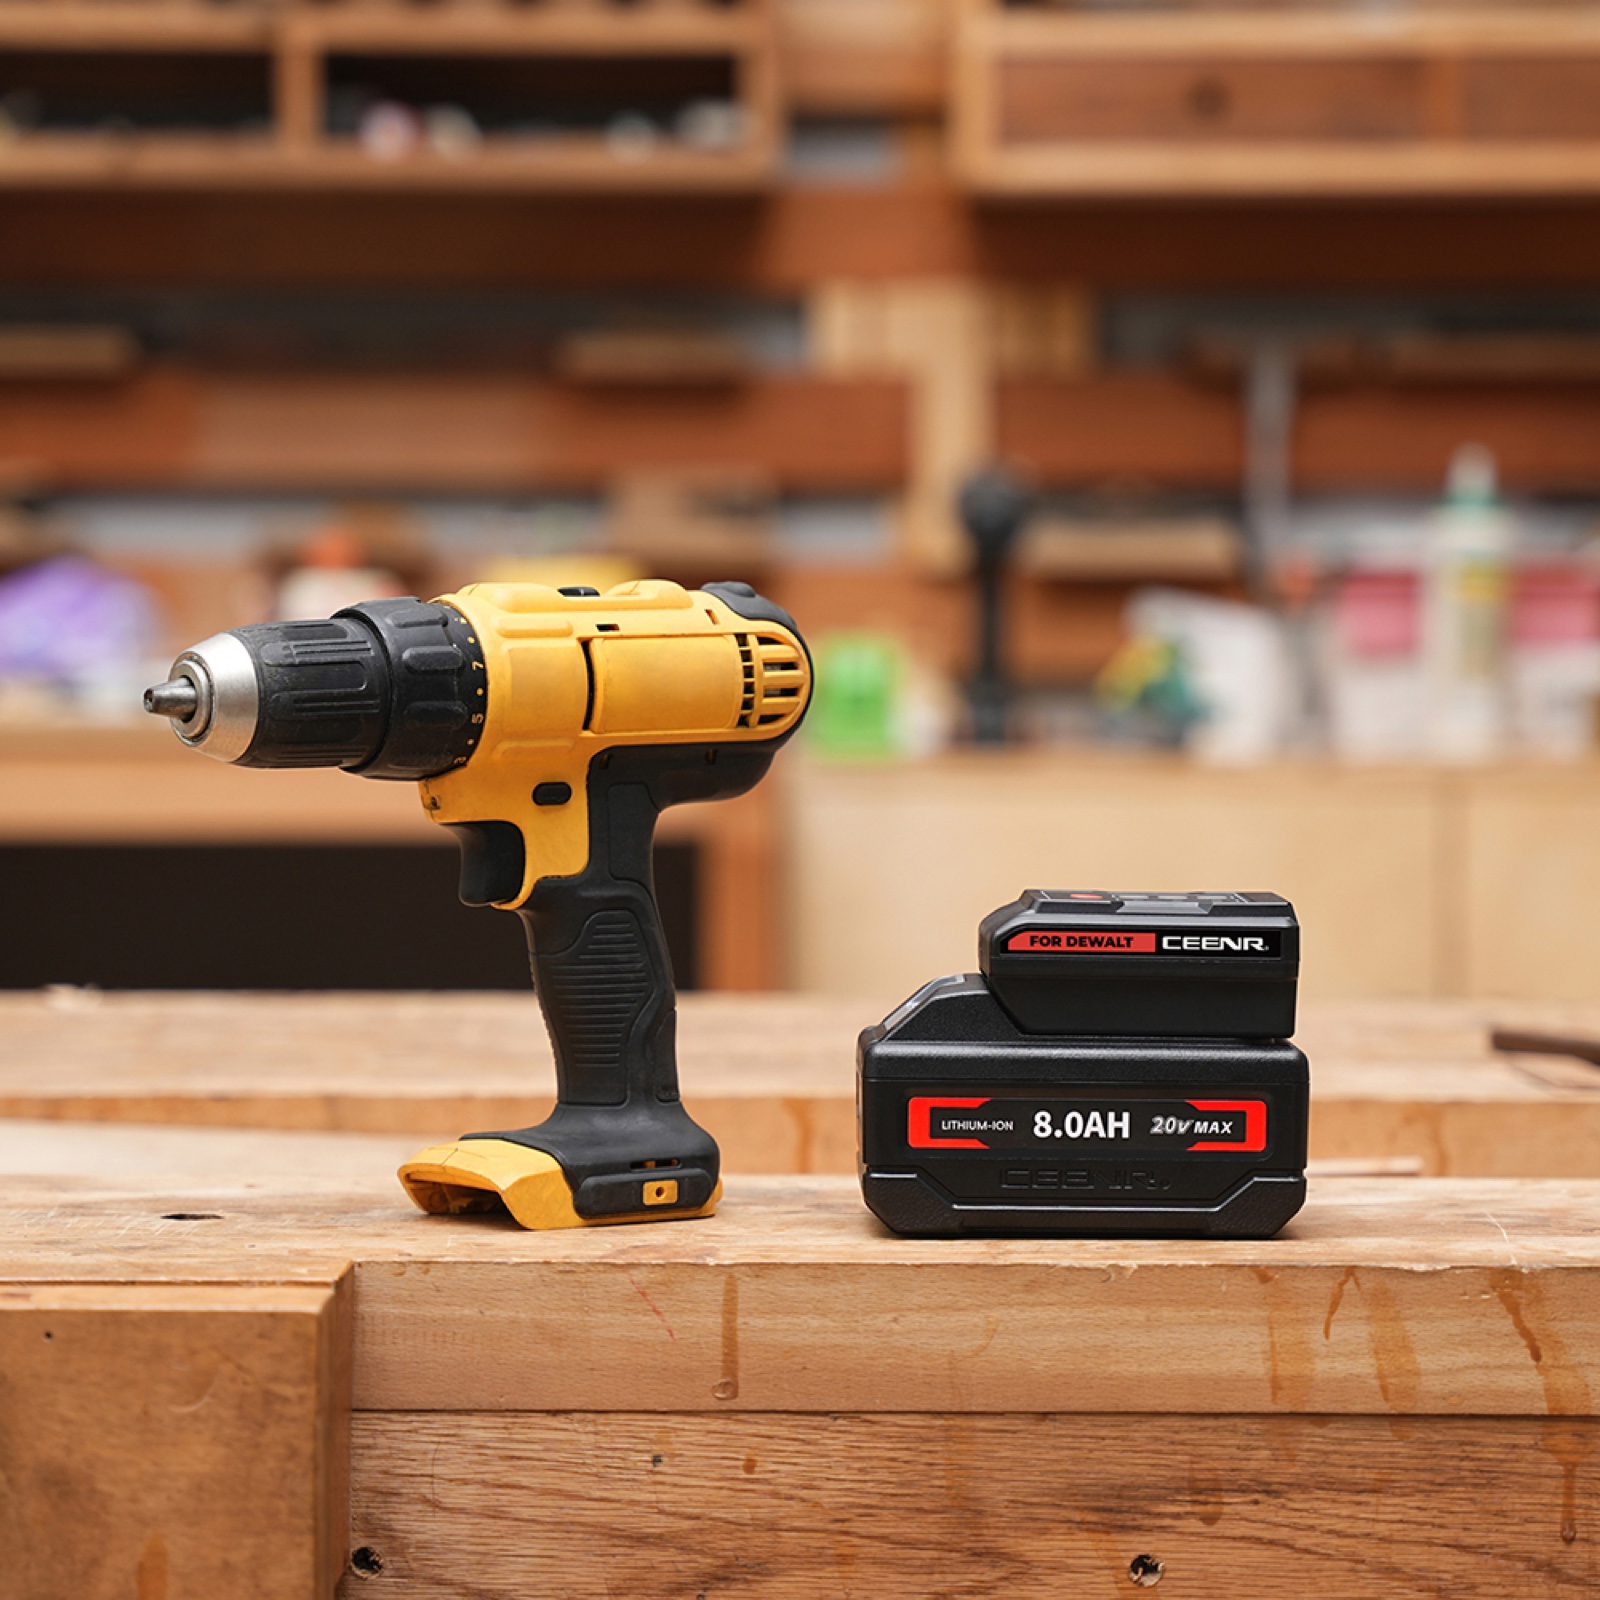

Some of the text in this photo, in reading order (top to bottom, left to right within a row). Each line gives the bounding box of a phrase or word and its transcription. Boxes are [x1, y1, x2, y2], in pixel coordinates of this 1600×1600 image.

[471, 661, 484, 670] 7
[471, 714, 484, 724] 5
[1030, 935, 1133, 948] FOR DEWALT
[941, 1119, 1014, 1132] LITHIUM-ION
[1033, 1111, 1130, 1139] 8.0AH
[1194, 1120, 1233, 1135] MAX
